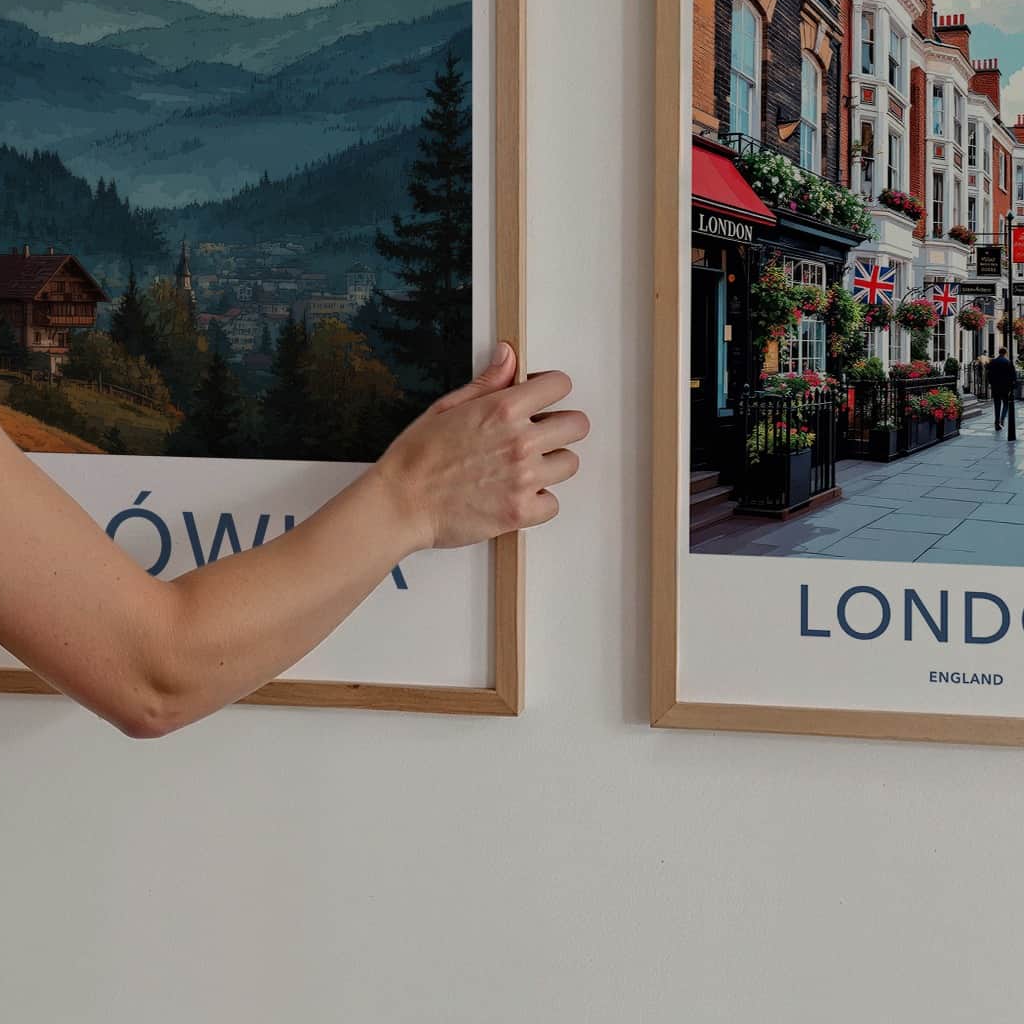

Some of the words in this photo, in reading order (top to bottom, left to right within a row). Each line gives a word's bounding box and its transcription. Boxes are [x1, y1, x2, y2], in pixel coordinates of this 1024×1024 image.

[698, 213, 753, 242] LONDON
[799, 583, 1024, 645] LOND
[928, 670, 1004, 686] ENGLAND
